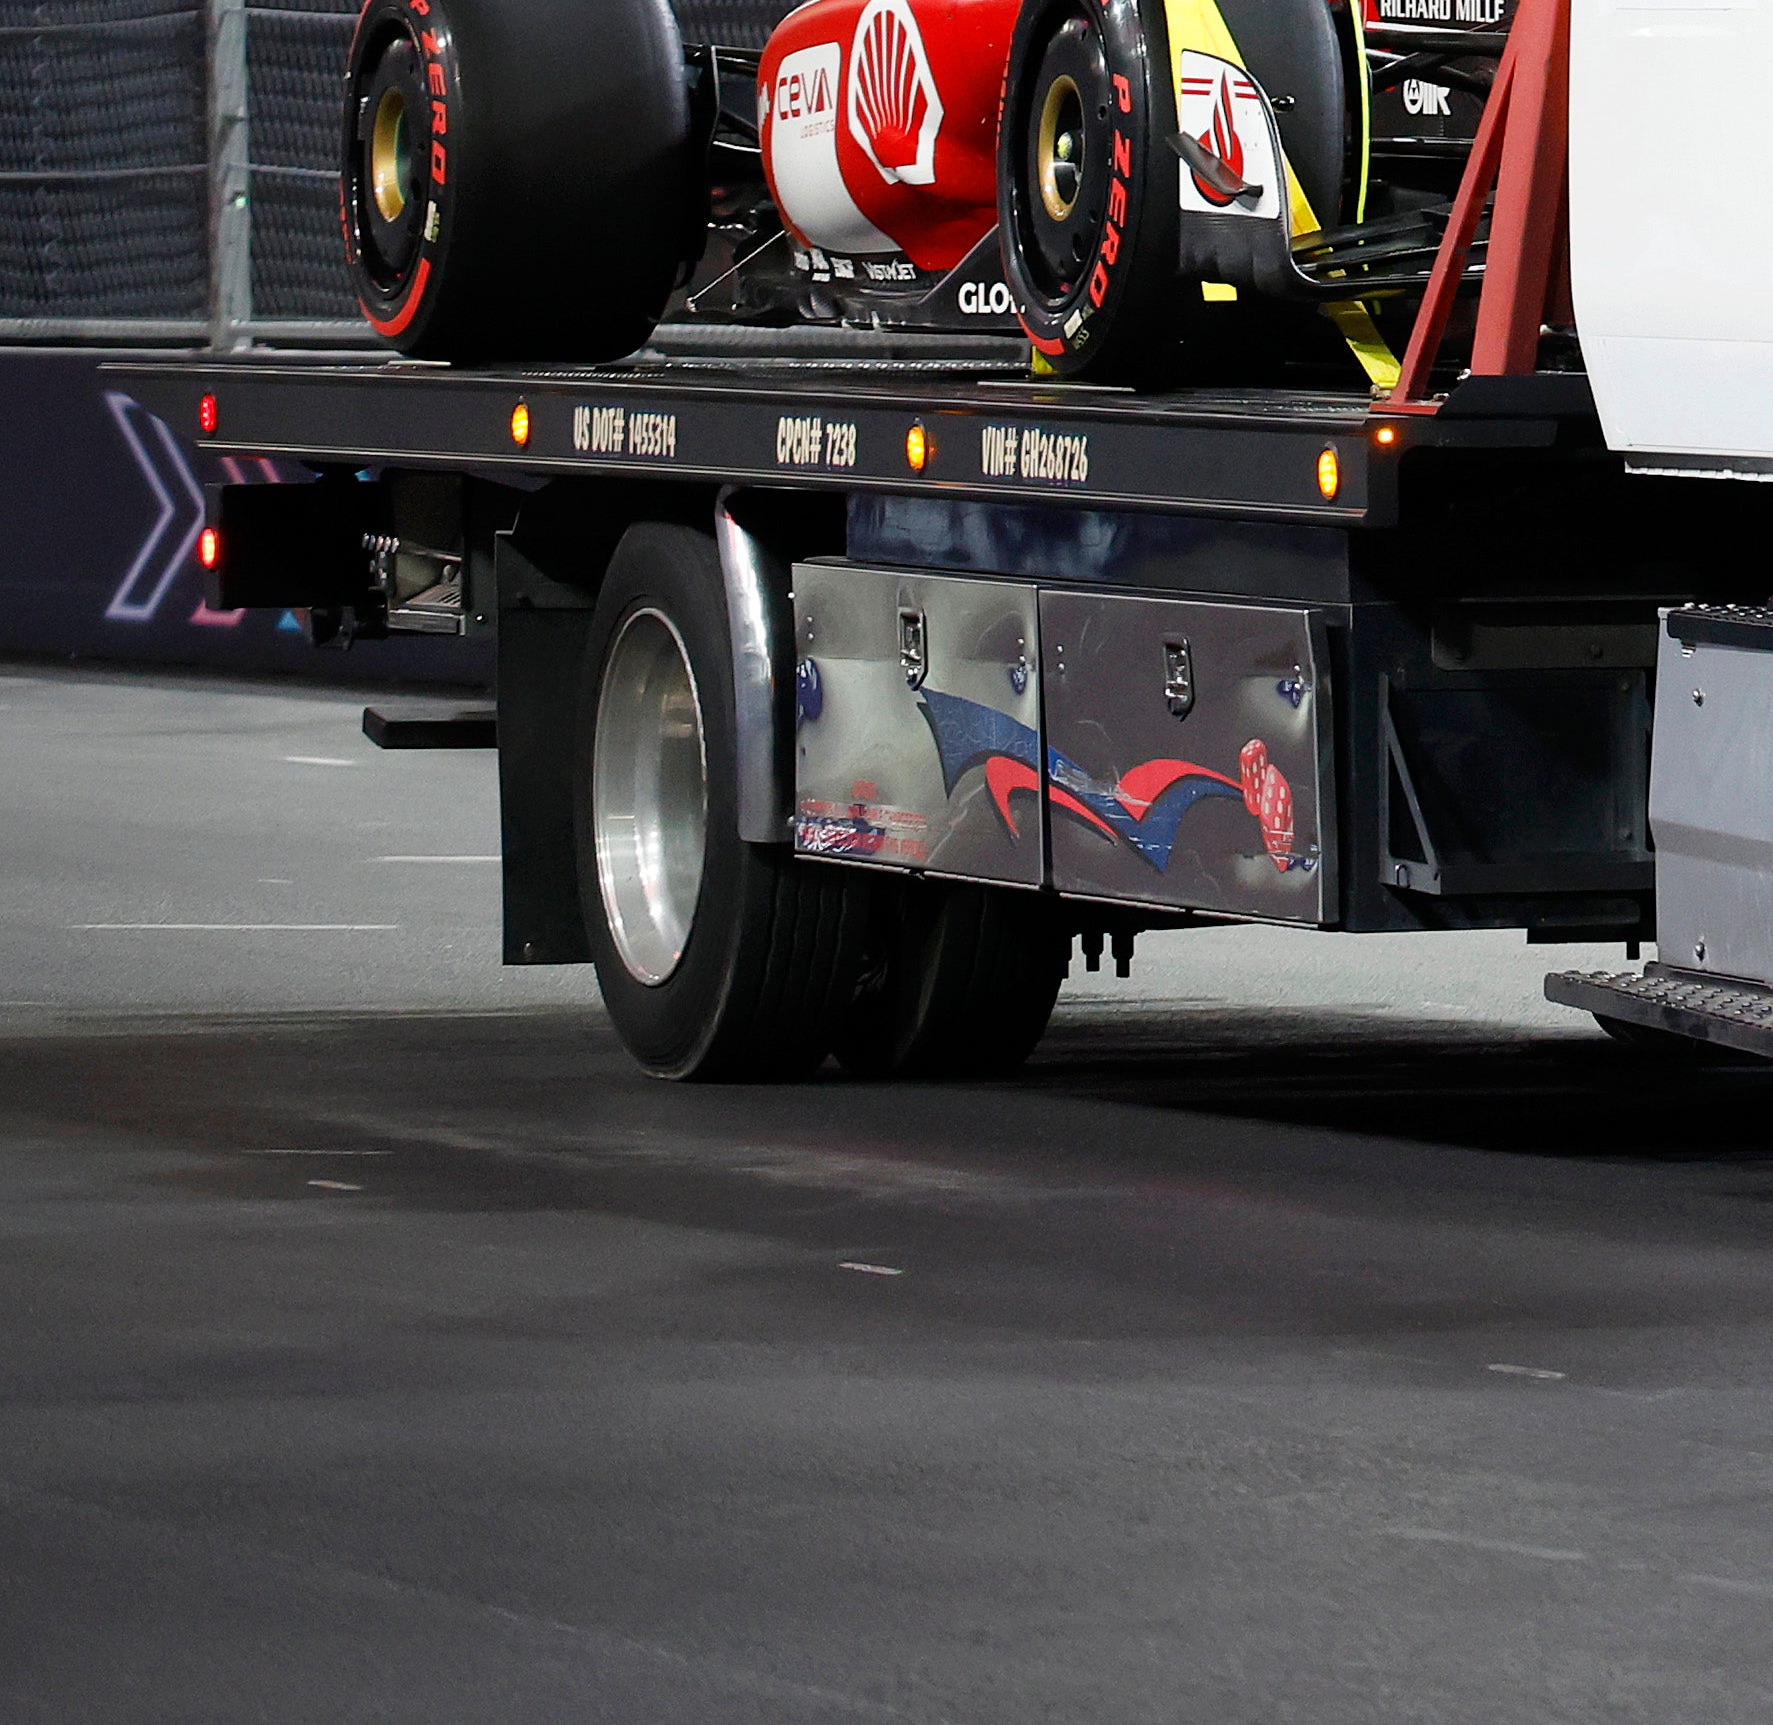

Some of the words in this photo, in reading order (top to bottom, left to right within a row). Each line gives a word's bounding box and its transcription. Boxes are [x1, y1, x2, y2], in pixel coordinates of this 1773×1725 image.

[420, 27, 448, 185] ZERO
[1113, 73, 1132, 114] P
[1087, 128, 1132, 309] ZERO
[573, 405, 591, 451] US
[592, 406, 625, 453] DOT#
[826, 422, 857, 467] 7238
[982, 425, 1019, 476] VIN#
